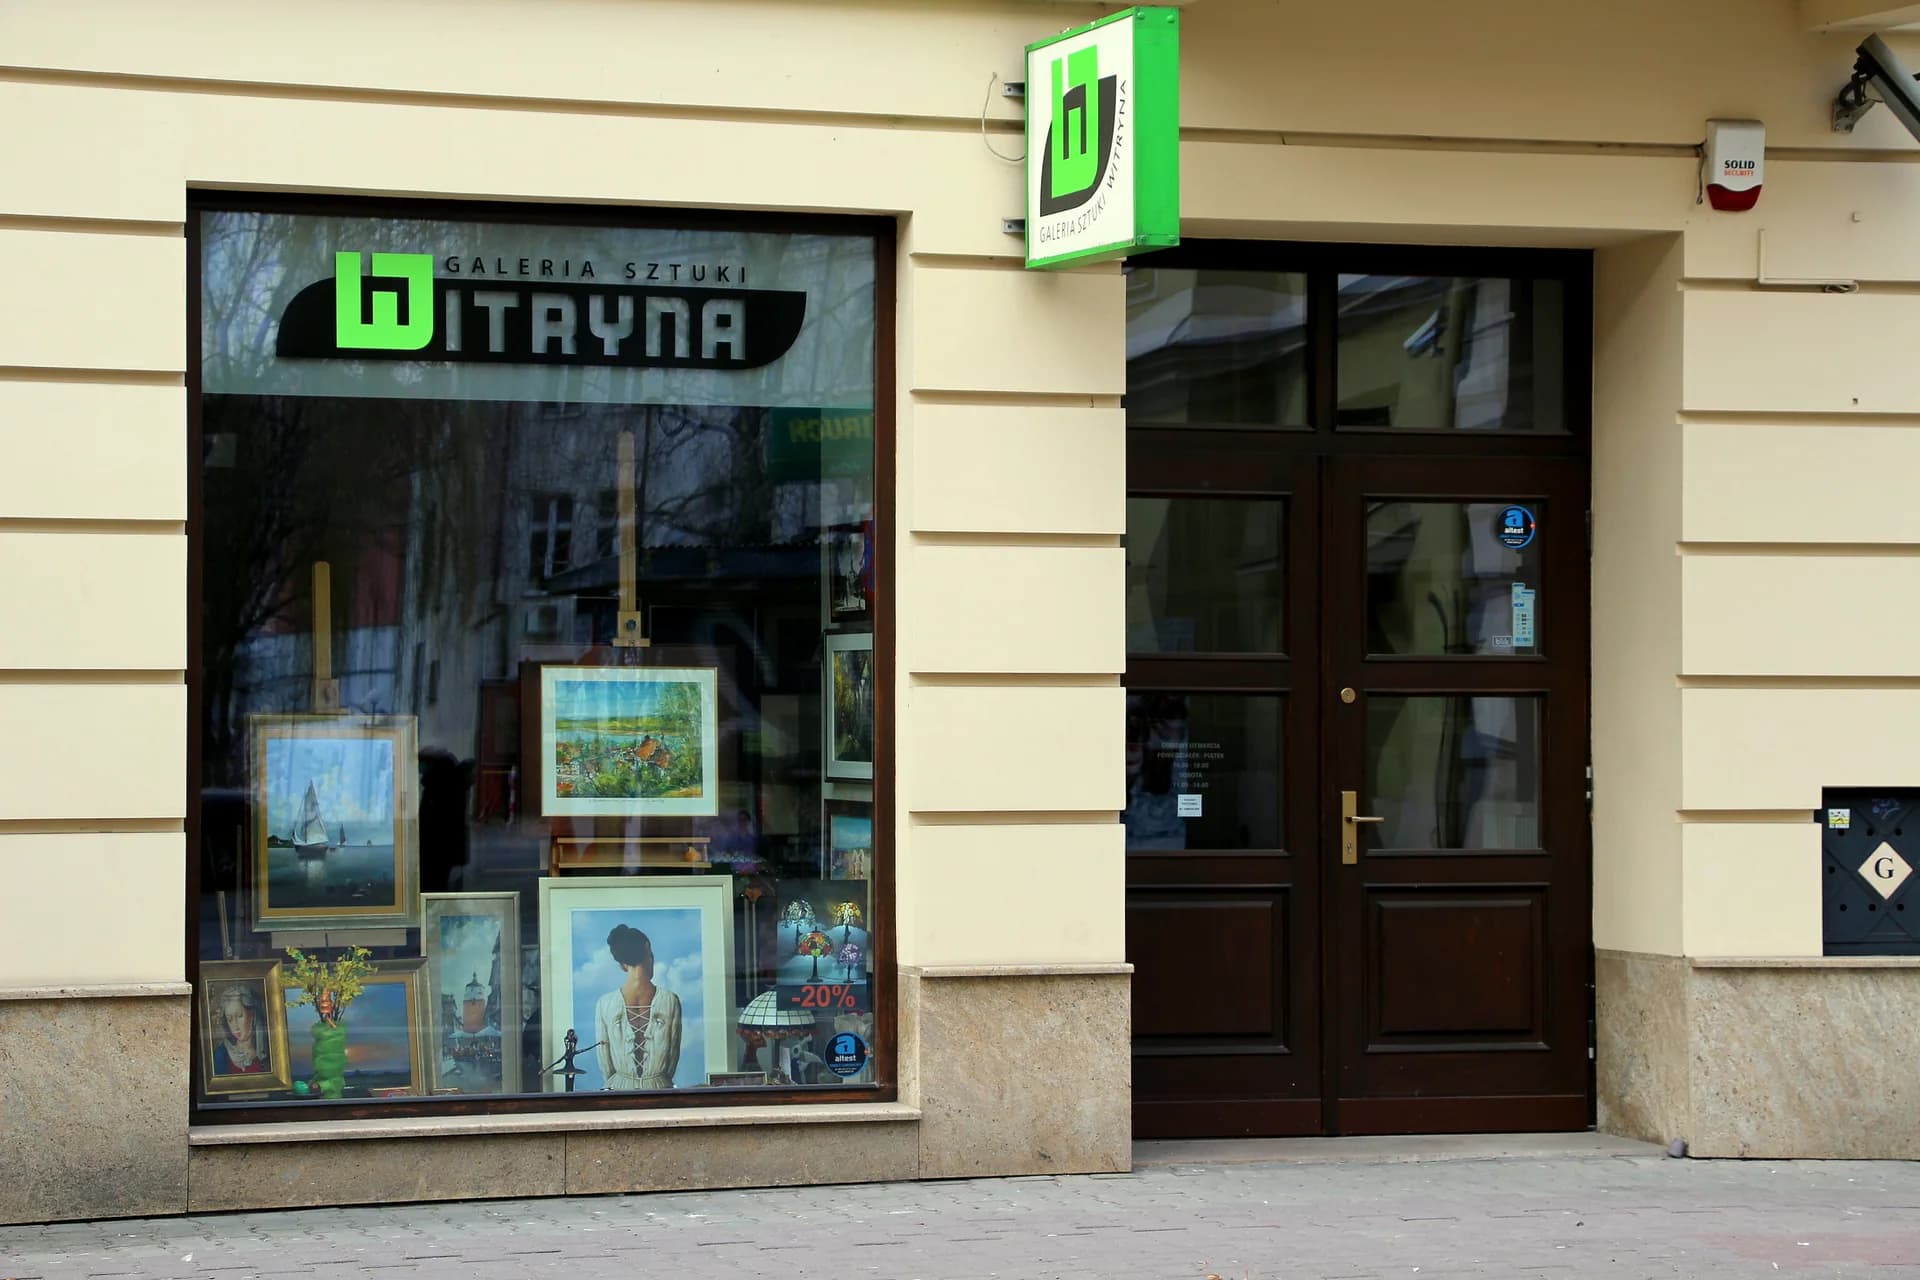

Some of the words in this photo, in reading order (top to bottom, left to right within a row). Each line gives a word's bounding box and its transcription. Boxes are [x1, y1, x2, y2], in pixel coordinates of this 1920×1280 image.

[1039, 220, 1076, 243] GALERIA
[1077, 195, 1106, 234] SZTUKI
[1107, 79, 1127, 189] WITRYNA
[1724, 159, 1755, 169] SOLID
[445, 255, 596, 278] GALERIA
[625, 261, 746, 284] SZTUKI
[1874, 857, 1894, 879] G
[791, 985, 856, 1008] -20%
